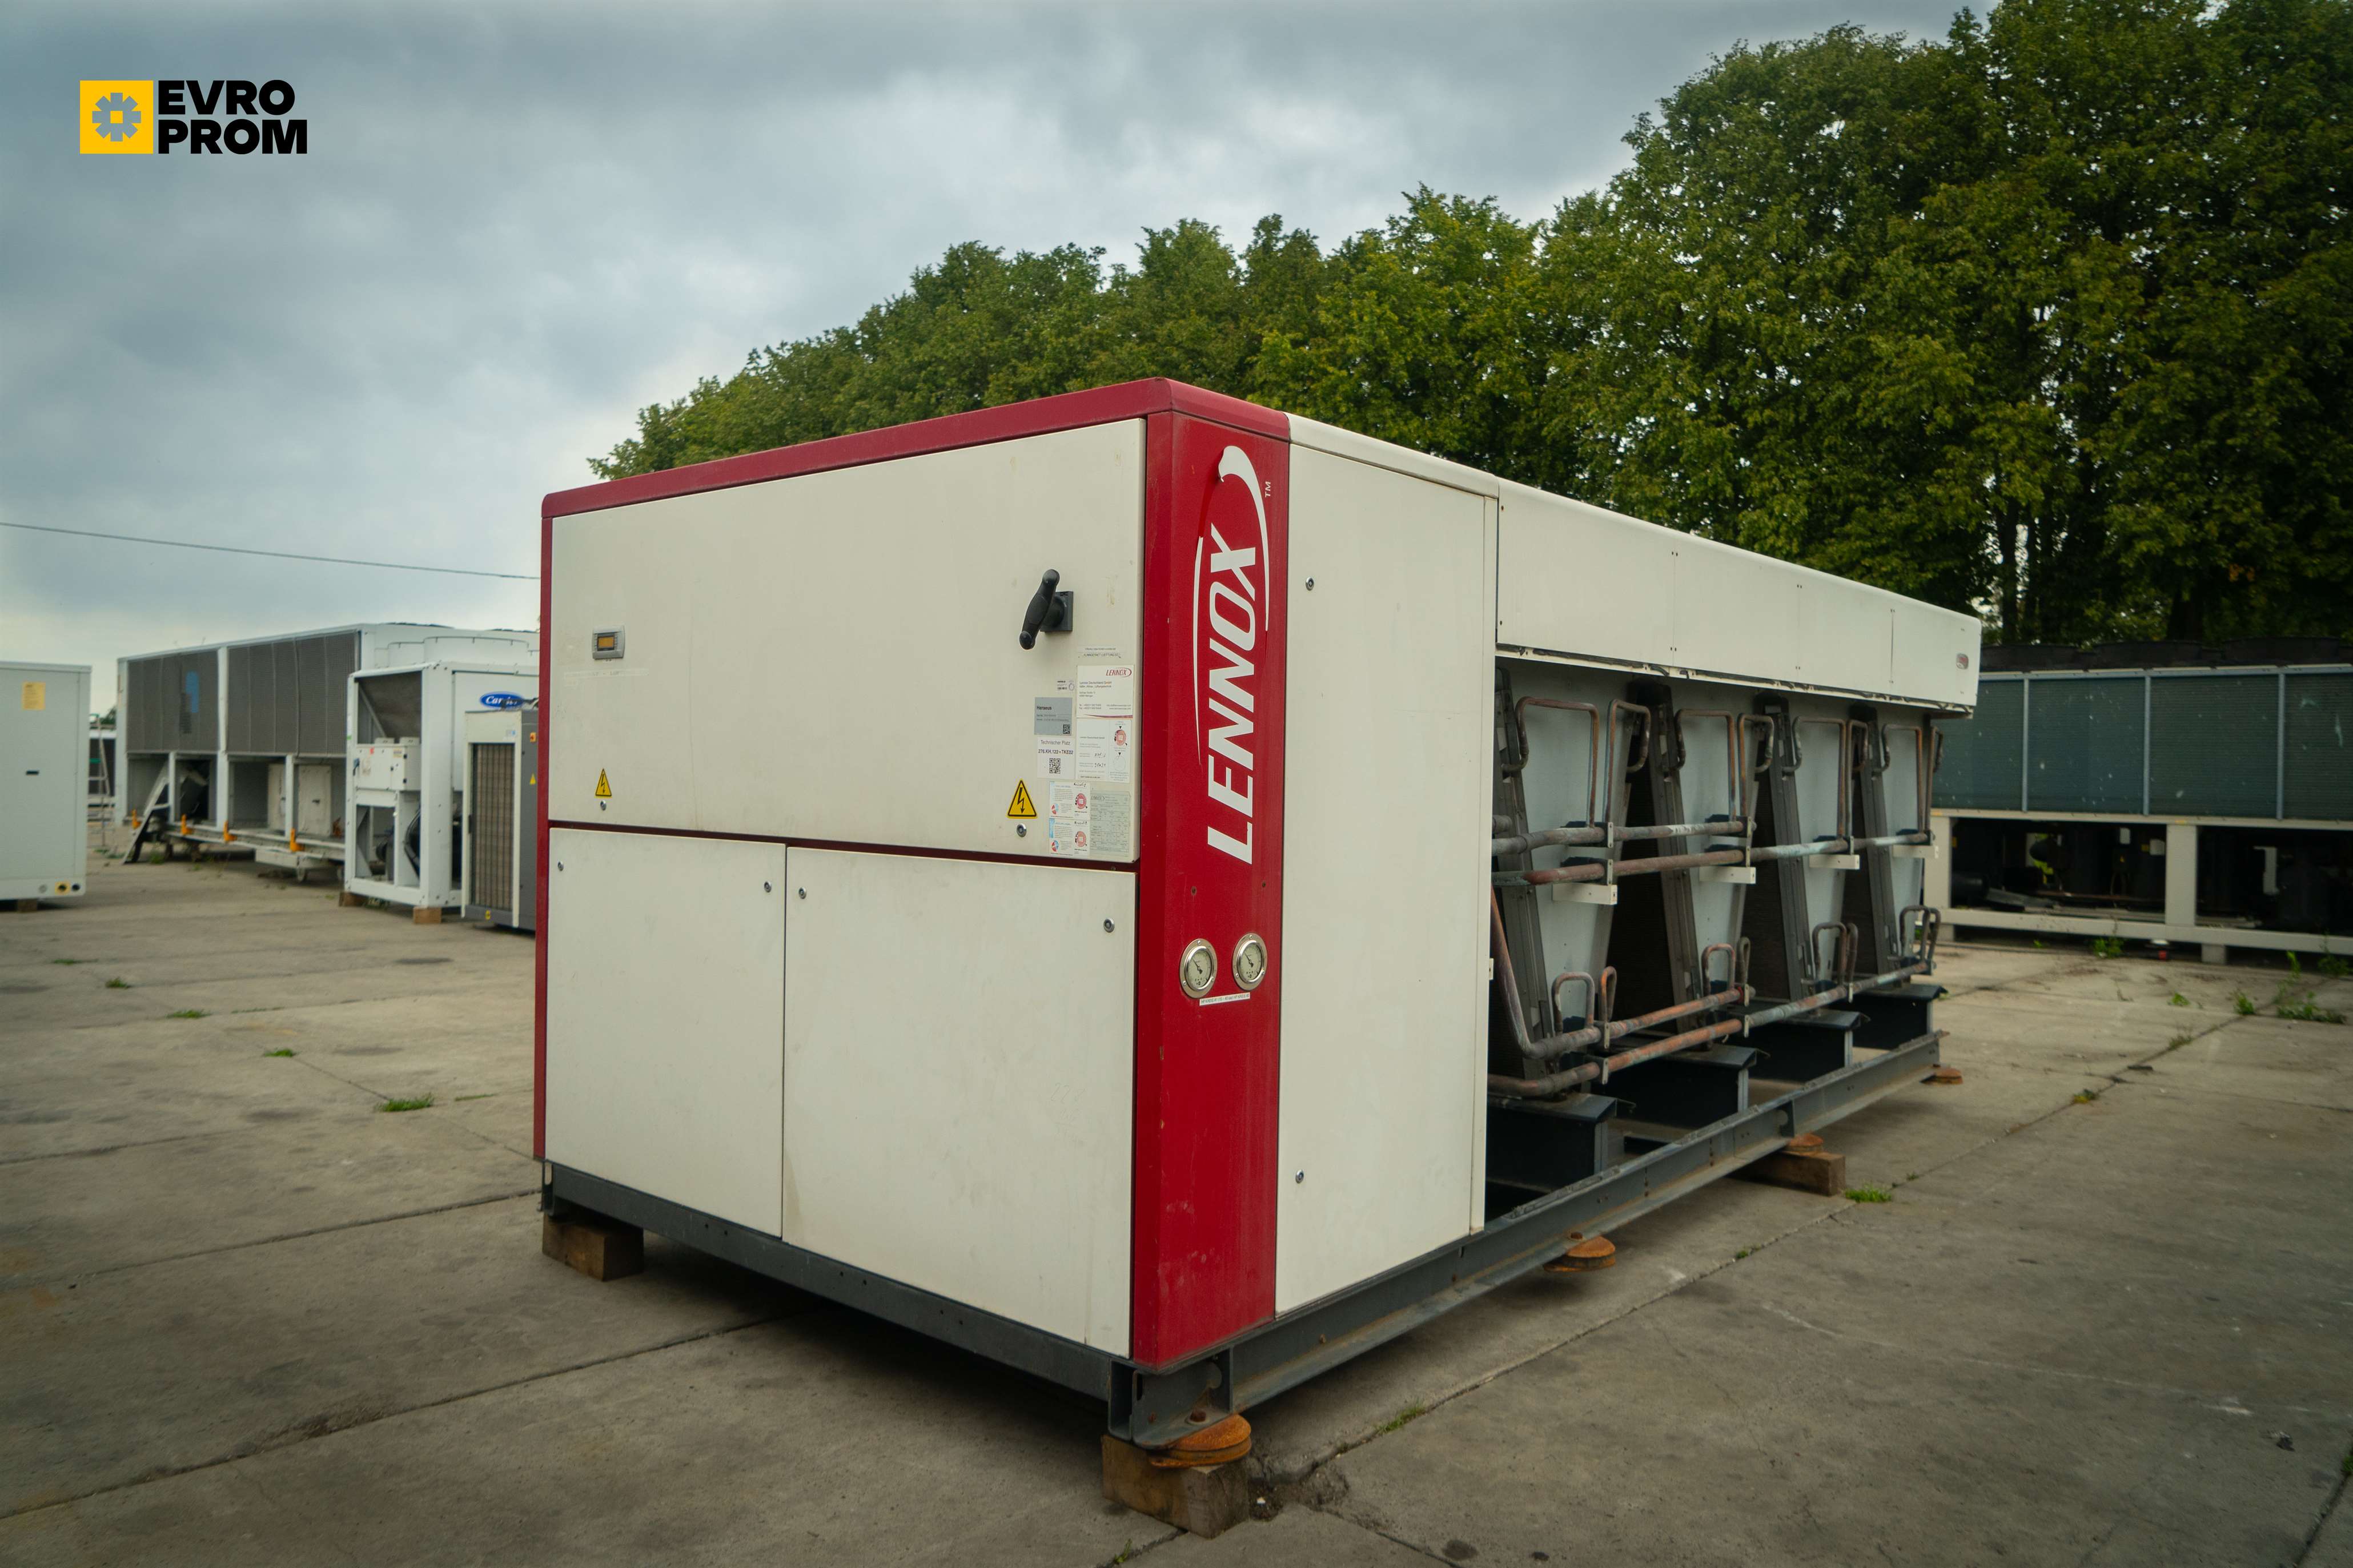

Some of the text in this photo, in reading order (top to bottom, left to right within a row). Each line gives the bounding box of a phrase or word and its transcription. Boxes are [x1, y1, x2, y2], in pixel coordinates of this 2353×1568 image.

[1265, 481, 1271, 497] TM
[485, 695, 518, 705] Carier
[1207, 523, 1256, 864] LENNOX
